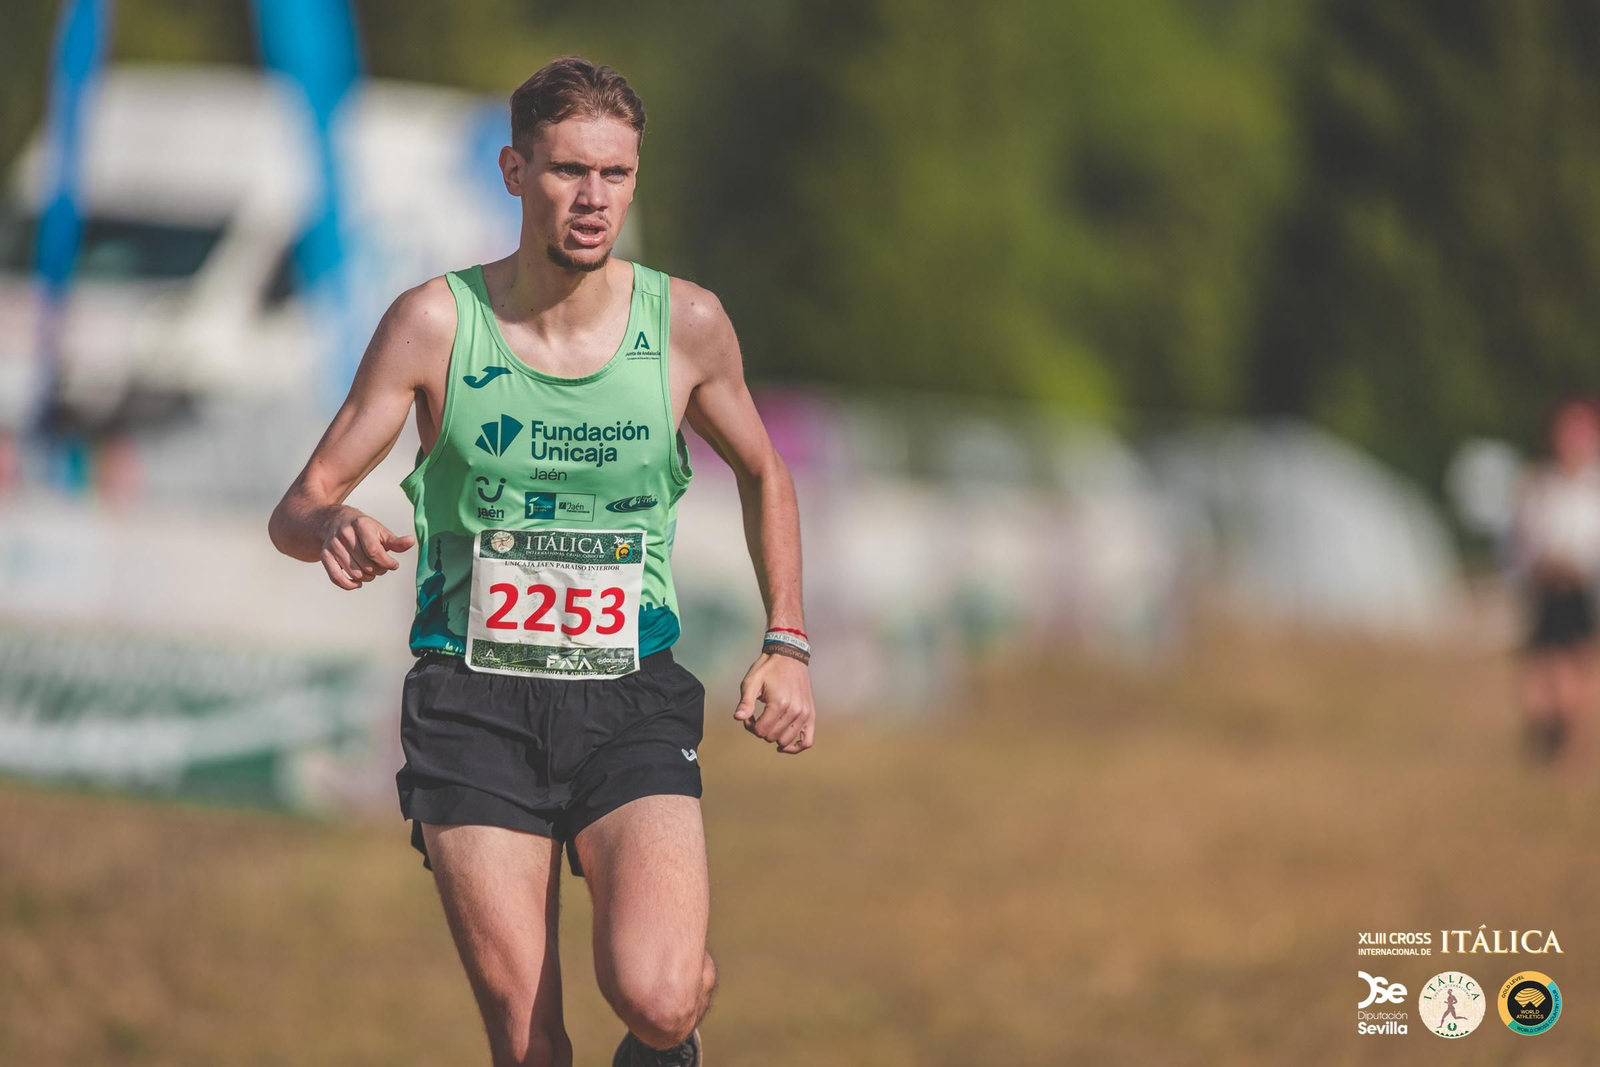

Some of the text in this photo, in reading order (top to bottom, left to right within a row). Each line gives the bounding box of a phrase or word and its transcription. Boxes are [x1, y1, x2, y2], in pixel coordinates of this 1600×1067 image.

[531, 420, 649, 441] Fundación
[531, 441, 617, 468] Unicaja
[530, 468, 567, 481] Jaén
[478, 505, 505, 519] jaén
[525, 533, 605, 554] ITÁLICA
[556, 563, 587, 571] PARAISO
[486, 583, 625, 636] 2253
